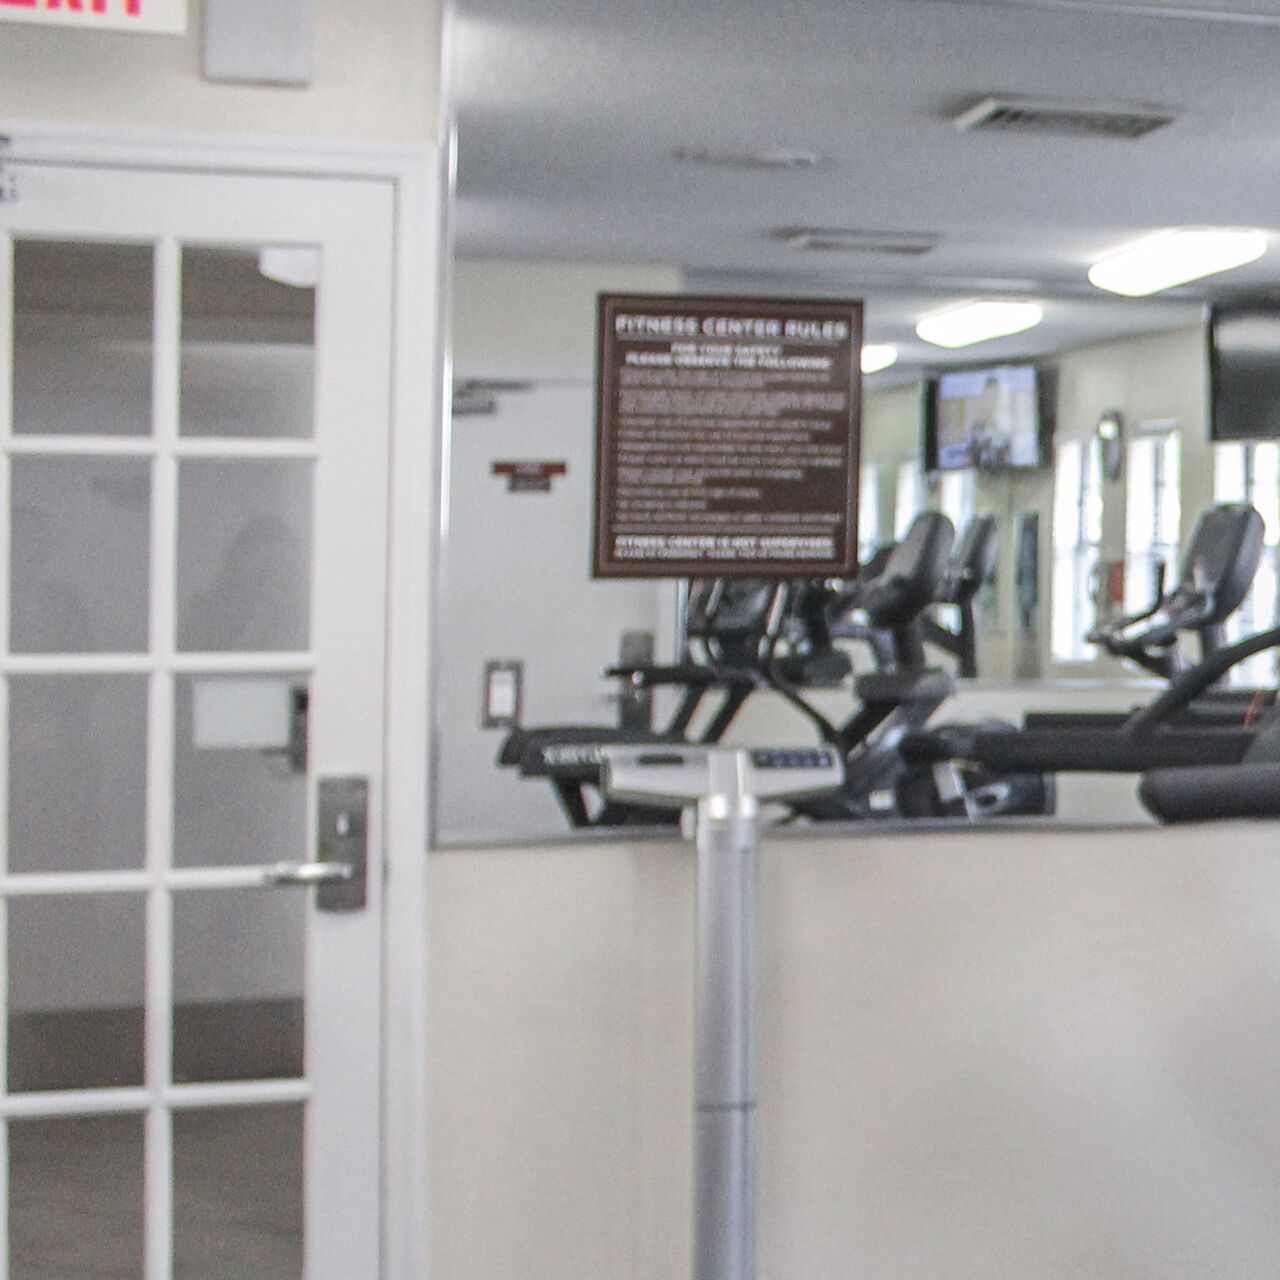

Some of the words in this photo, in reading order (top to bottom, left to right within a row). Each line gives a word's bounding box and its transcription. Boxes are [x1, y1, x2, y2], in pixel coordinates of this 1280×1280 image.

[615, 314, 699, 336] FITNESS
[702, 317, 782, 338] CENTER
[785, 319, 849, 340] RULES
